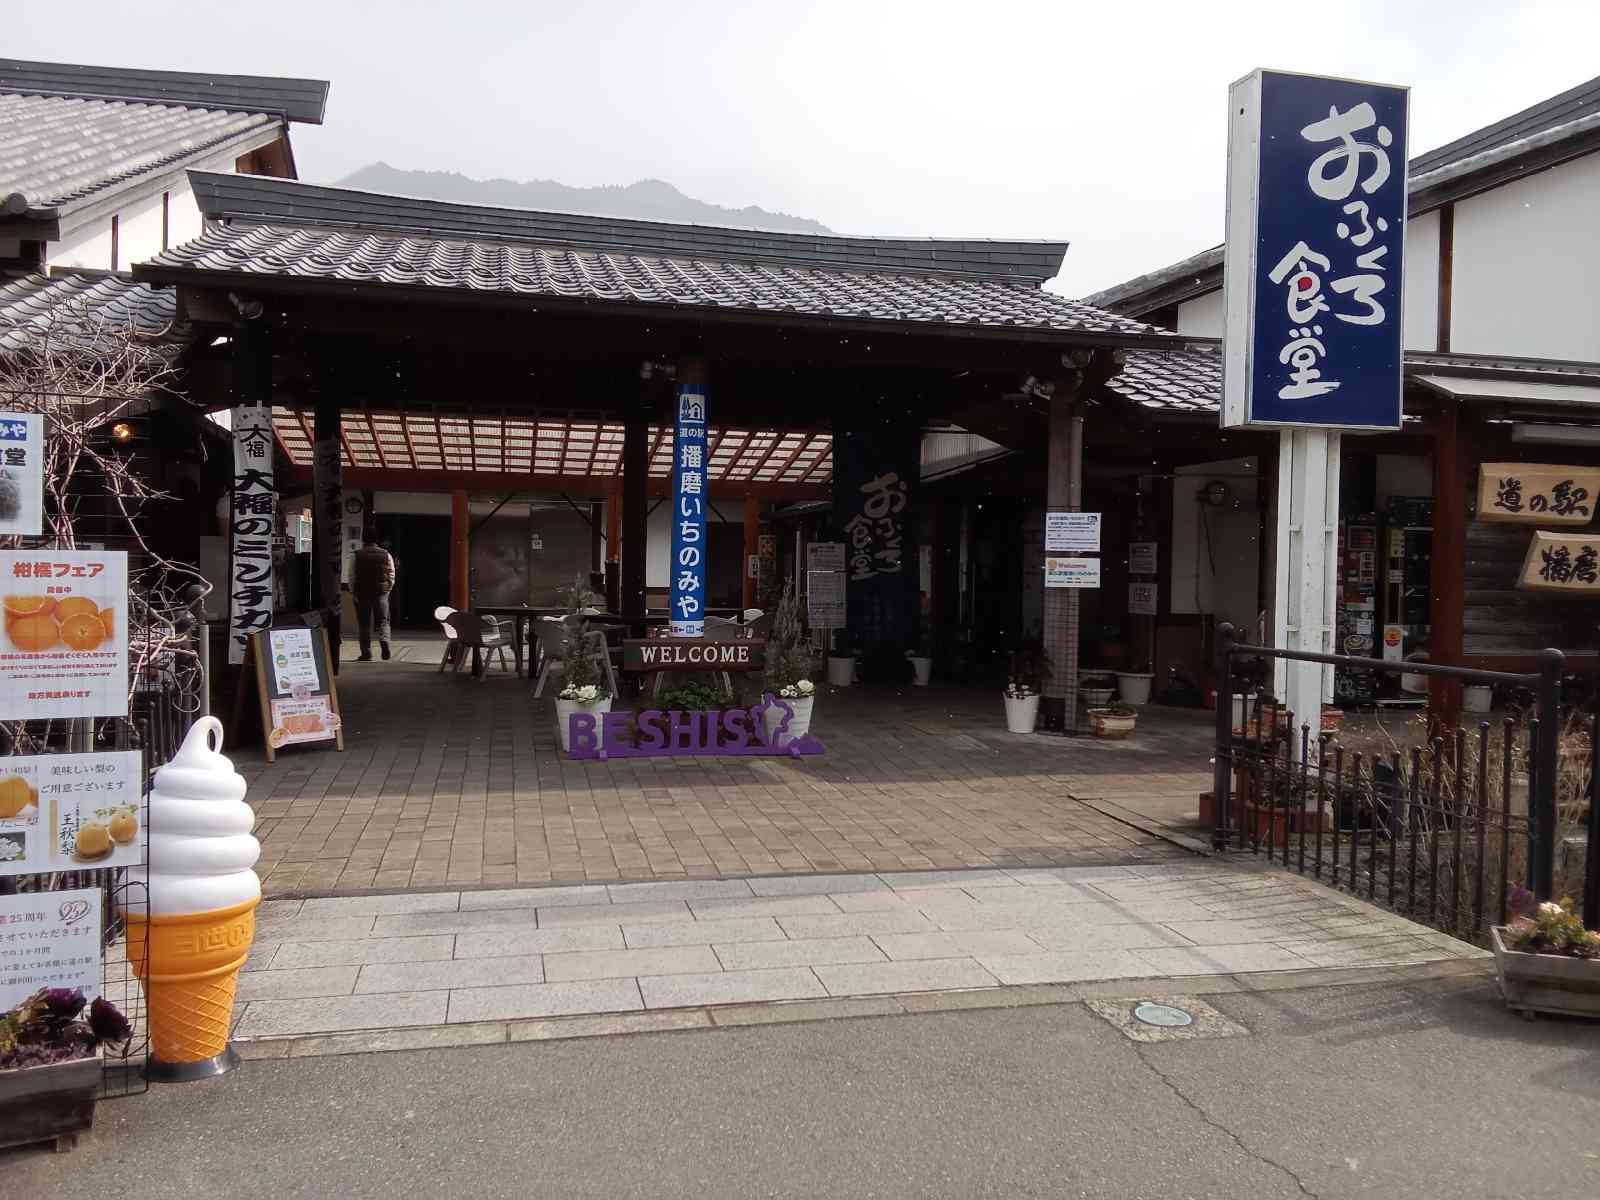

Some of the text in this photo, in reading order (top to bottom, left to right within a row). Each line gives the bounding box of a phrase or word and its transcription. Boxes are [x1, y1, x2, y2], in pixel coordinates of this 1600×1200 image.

[1300, 102, 1392, 325] おふくろ
[1268, 241, 1340, 399] 食堂
[677, 445, 703, 619] 播磨いちのみや
[1494, 477, 1588, 516] 道の駅
[640, 646, 749, 662] WELCOME
